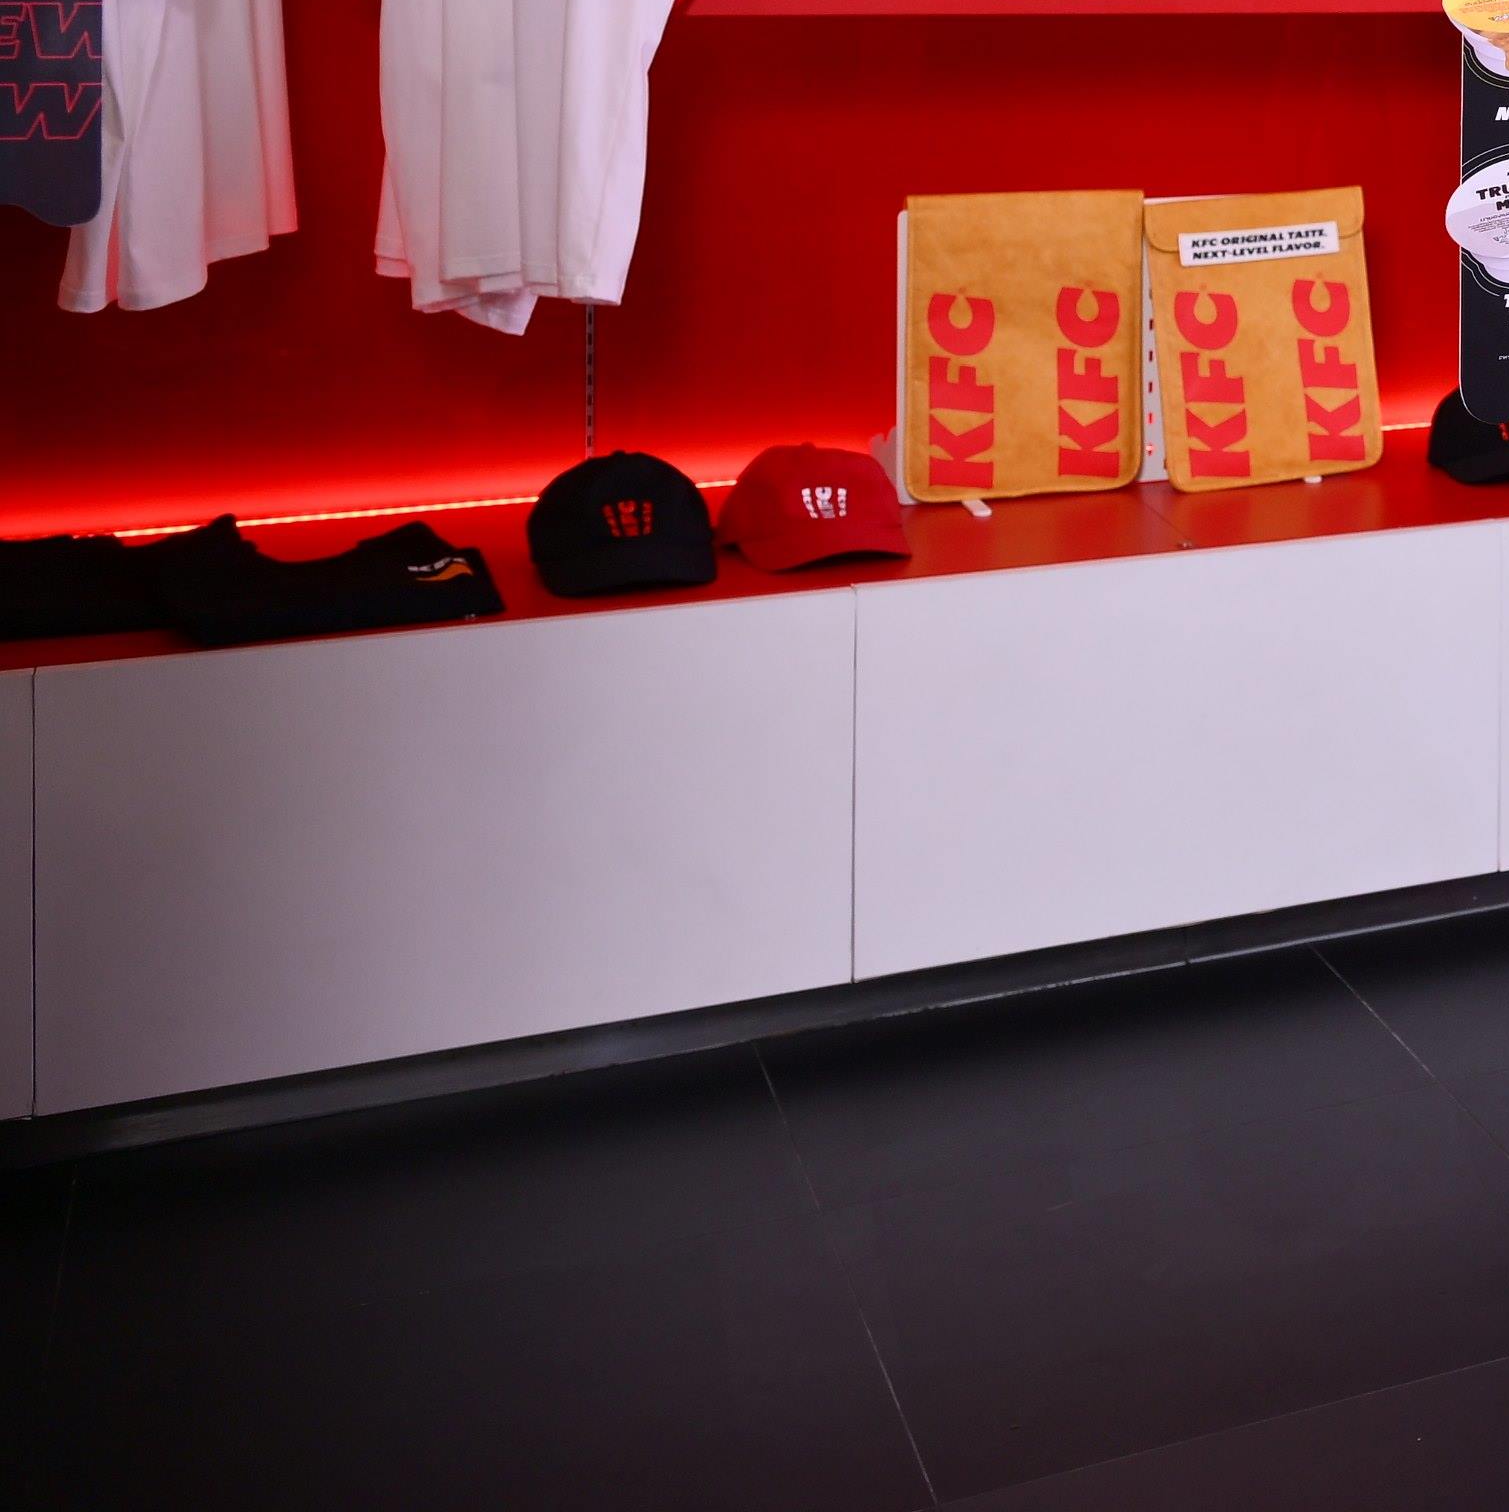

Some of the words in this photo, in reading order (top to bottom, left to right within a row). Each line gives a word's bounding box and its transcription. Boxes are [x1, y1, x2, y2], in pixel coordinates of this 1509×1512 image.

[1191, 238, 1217, 248] KFC
[1221, 231, 1284, 246] ORIGINAL
[928, 291, 996, 489] KFC
[1056, 285, 1121, 480] KFC
[1174, 289, 1252, 478] KFC
[1290, 277, 1367, 462] KFC
